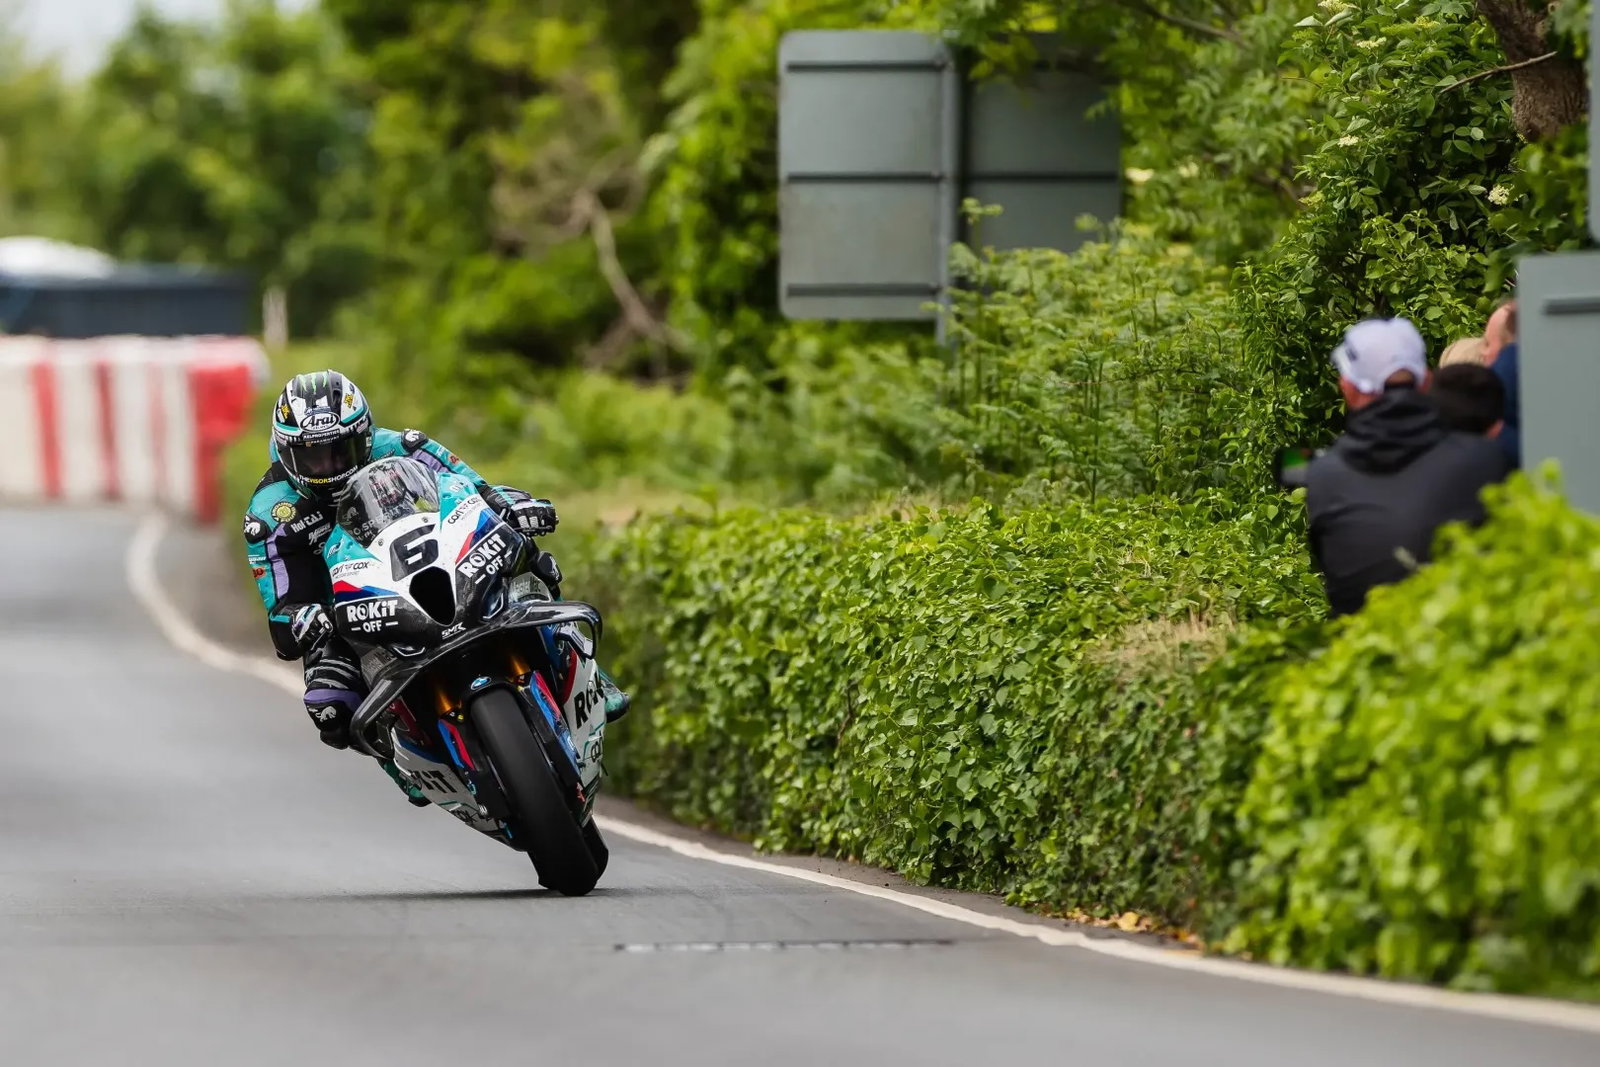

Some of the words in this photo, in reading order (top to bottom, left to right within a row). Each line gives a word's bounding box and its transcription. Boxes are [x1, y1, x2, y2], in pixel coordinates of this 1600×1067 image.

[303, 414, 334, 428] Arai
[389, 523, 439, 582] 6
[457, 533, 507, 578] ROKiT
[485, 555, 504, 575] OFF
[346, 599, 398, 623] ROKiT
[362, 620, 382, 633] OFF
[573, 671, 605, 730] ROK
